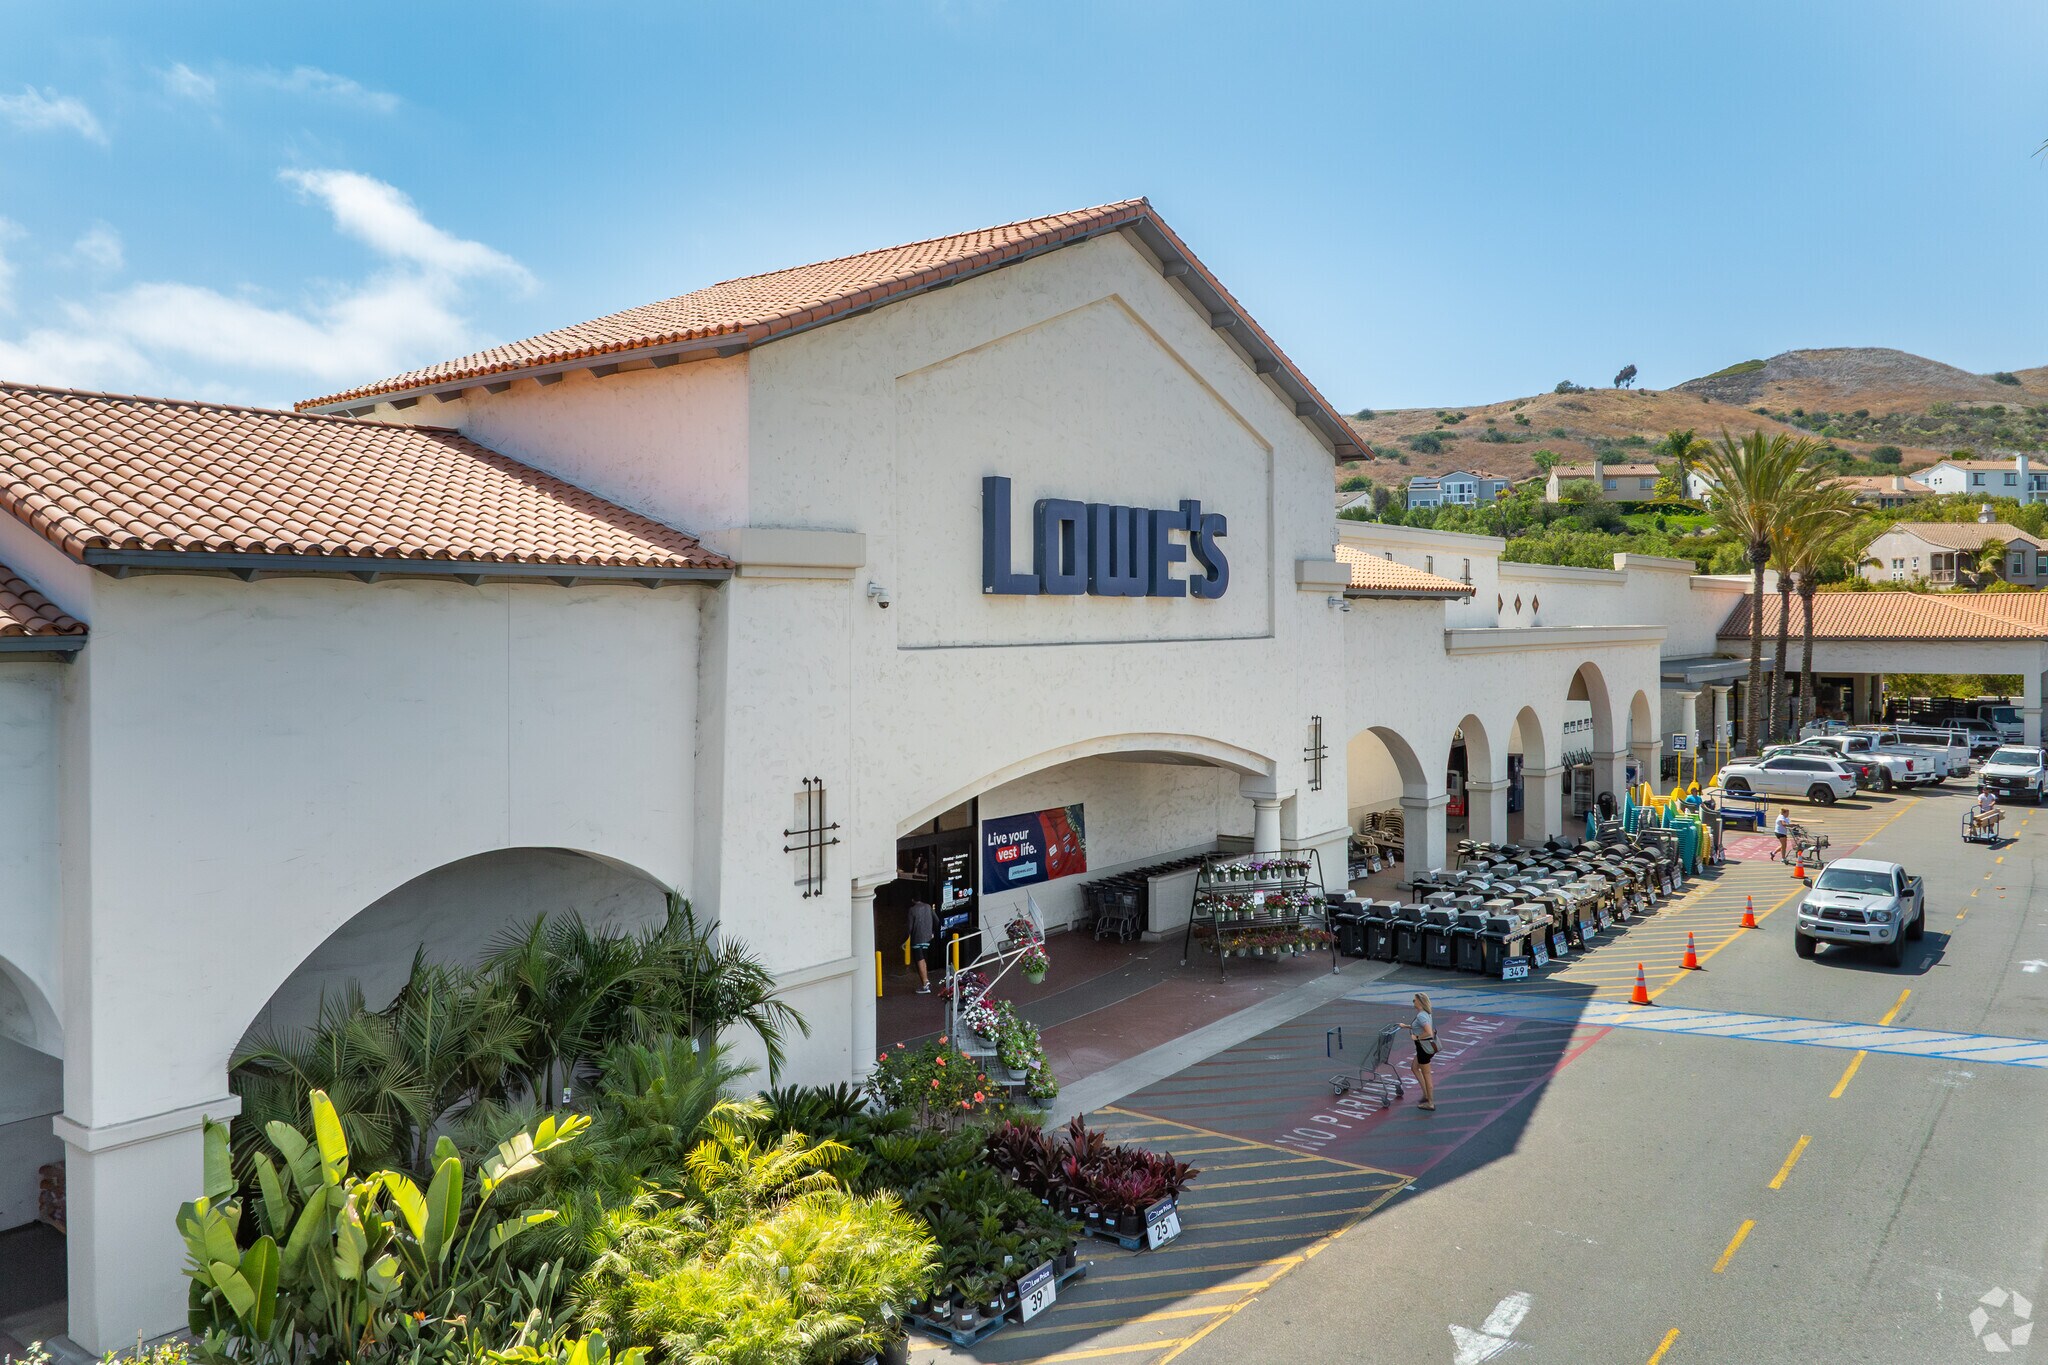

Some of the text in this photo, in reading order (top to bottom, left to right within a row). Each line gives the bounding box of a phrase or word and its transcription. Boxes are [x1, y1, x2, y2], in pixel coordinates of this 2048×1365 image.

[983, 476, 1229, 600] LOWE'S
[988, 829, 1029, 846] Live your
[997, 846, 1017, 860] vest
[1020, 841, 1037, 856] life.
[1509, 966, 1525, 977] 349
[1274, 1126, 1337, 1151] NO
[1439, 1015, 1505, 1046] LANE
[1155, 1218, 1168, 1241] 25
[1031, 1289, 1043, 1312] 39
